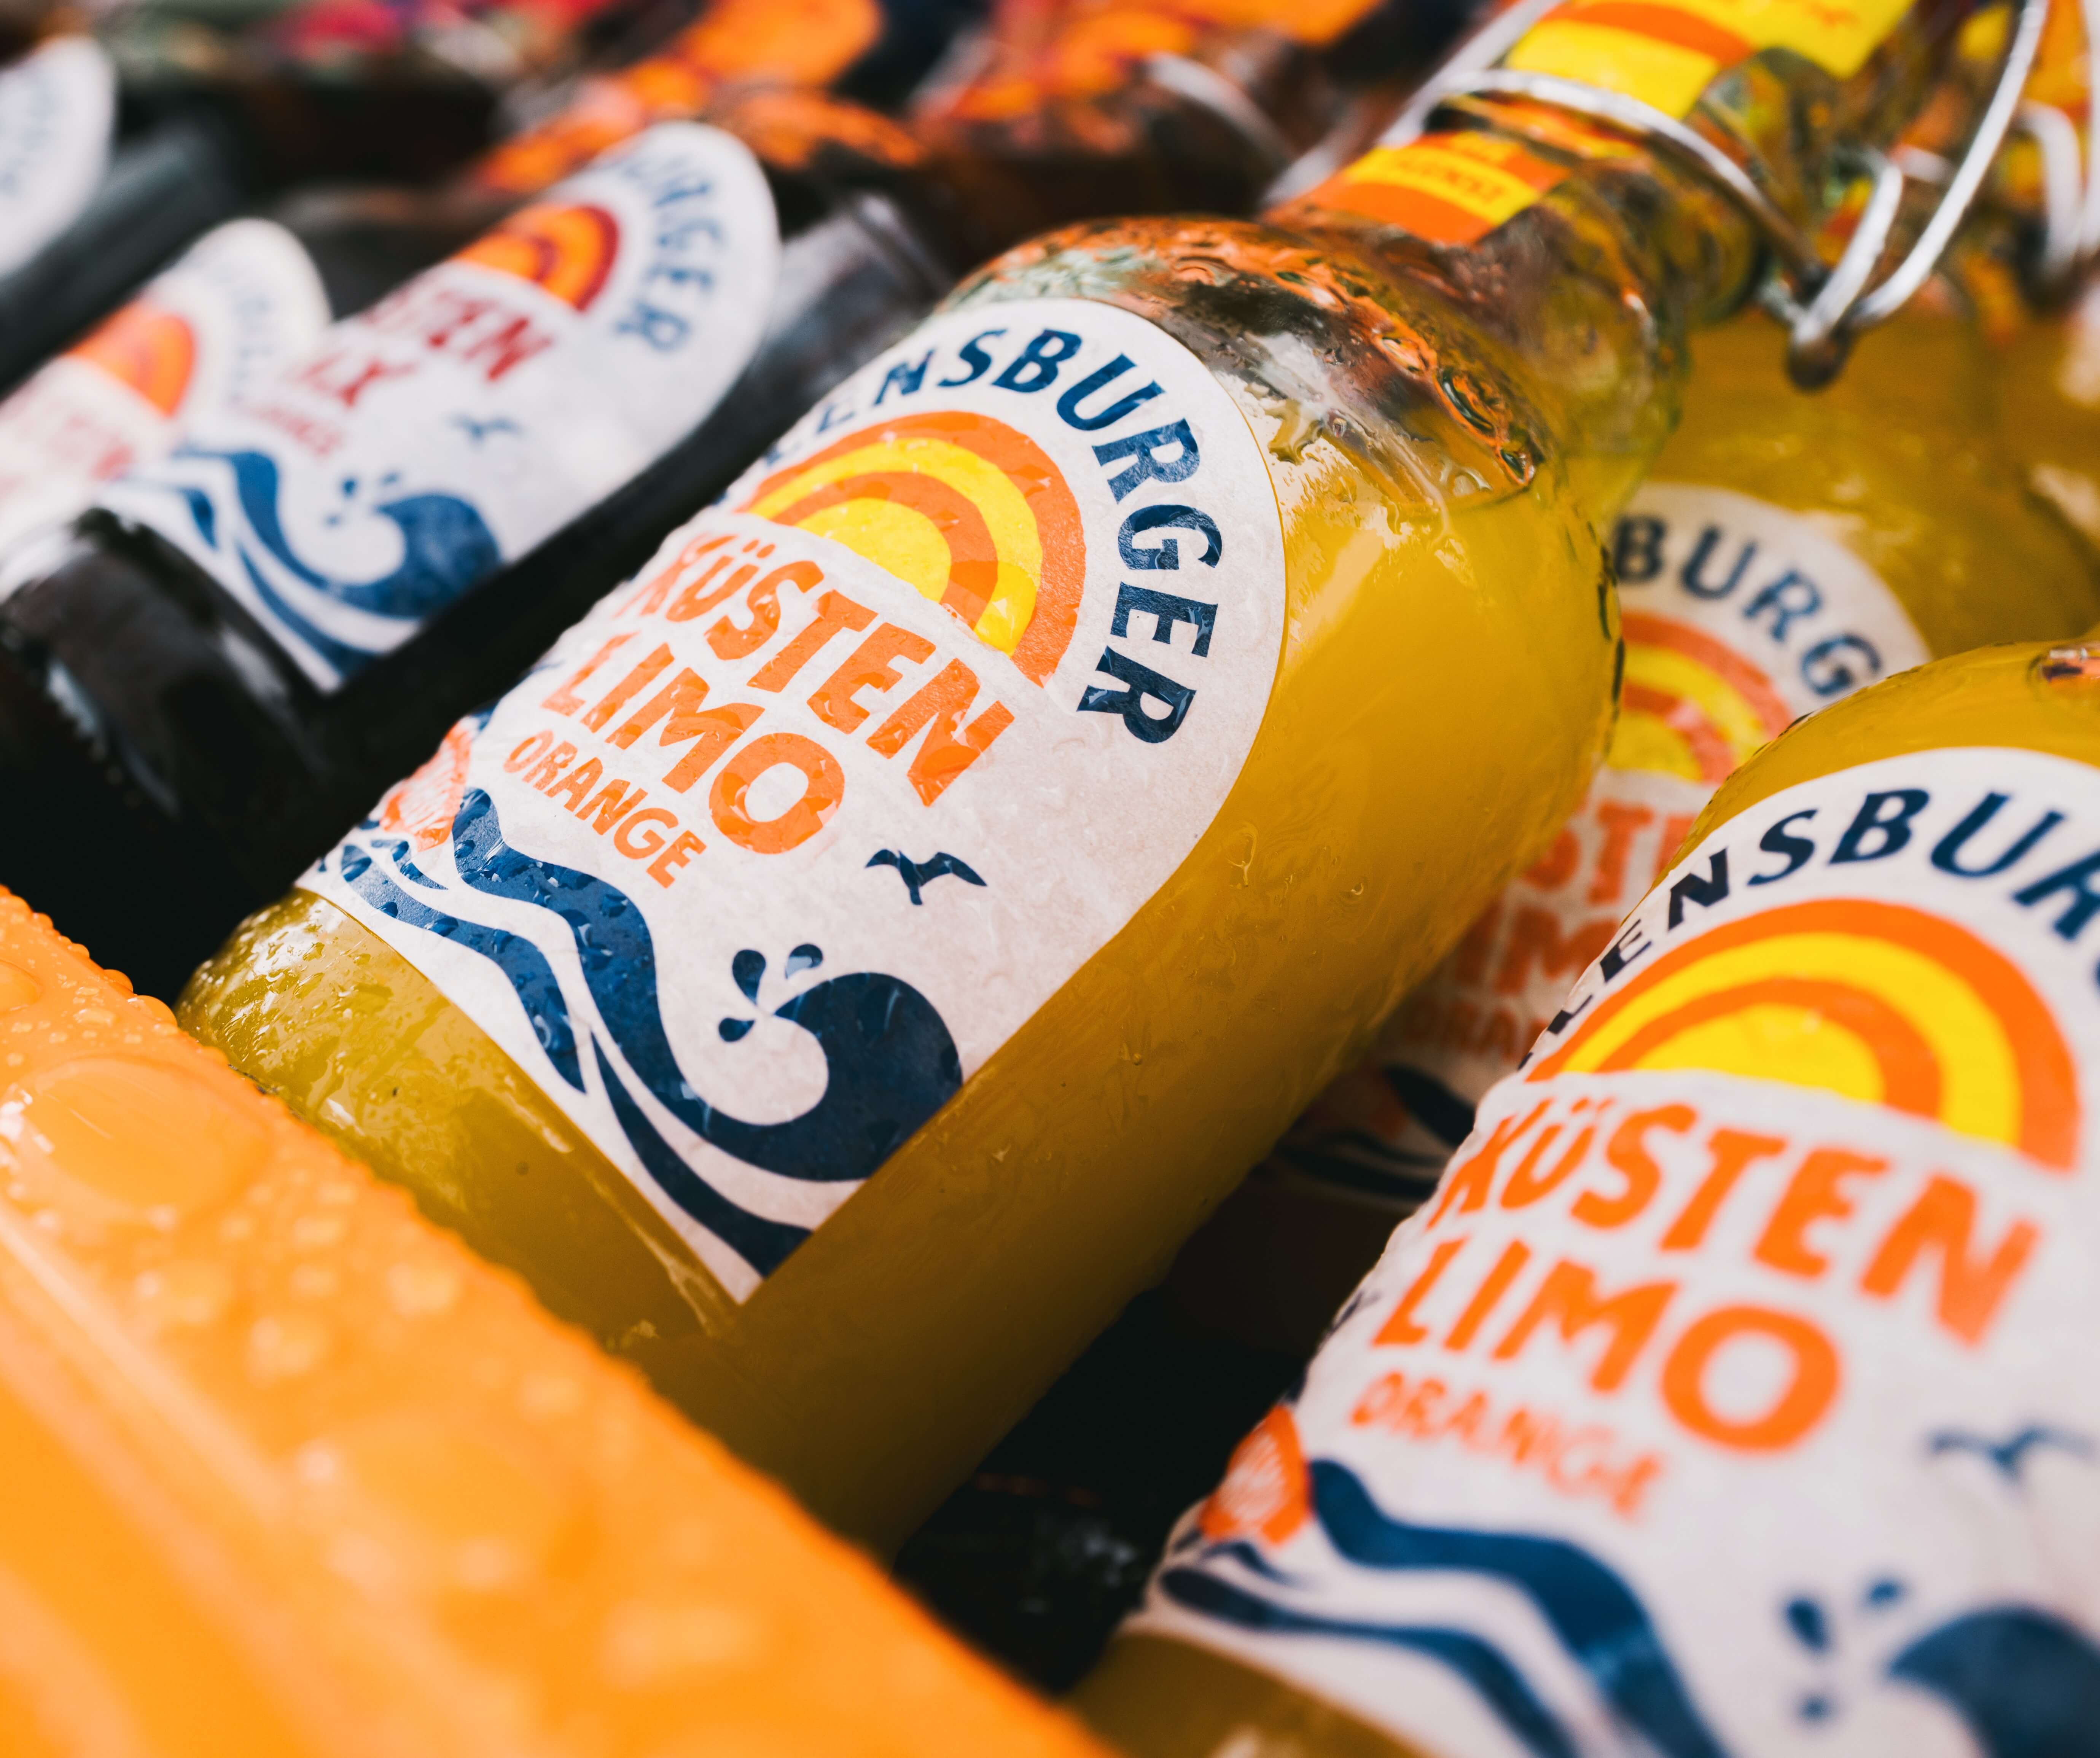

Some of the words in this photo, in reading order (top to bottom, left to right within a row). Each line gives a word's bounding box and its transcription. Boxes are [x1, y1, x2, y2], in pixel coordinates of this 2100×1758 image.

[613, 533, 1015, 807] KÜSTEN
[1613, 513, 1883, 696] BURG
[502, 729, 707, 889] ORANGE
[541, 632, 845, 854] LIMO
[1425, 1097, 2040, 1349] KÜSTEN
[1348, 1370, 1663, 1520] ORANGE
[1371, 1237, 1842, 1457] LIMO
